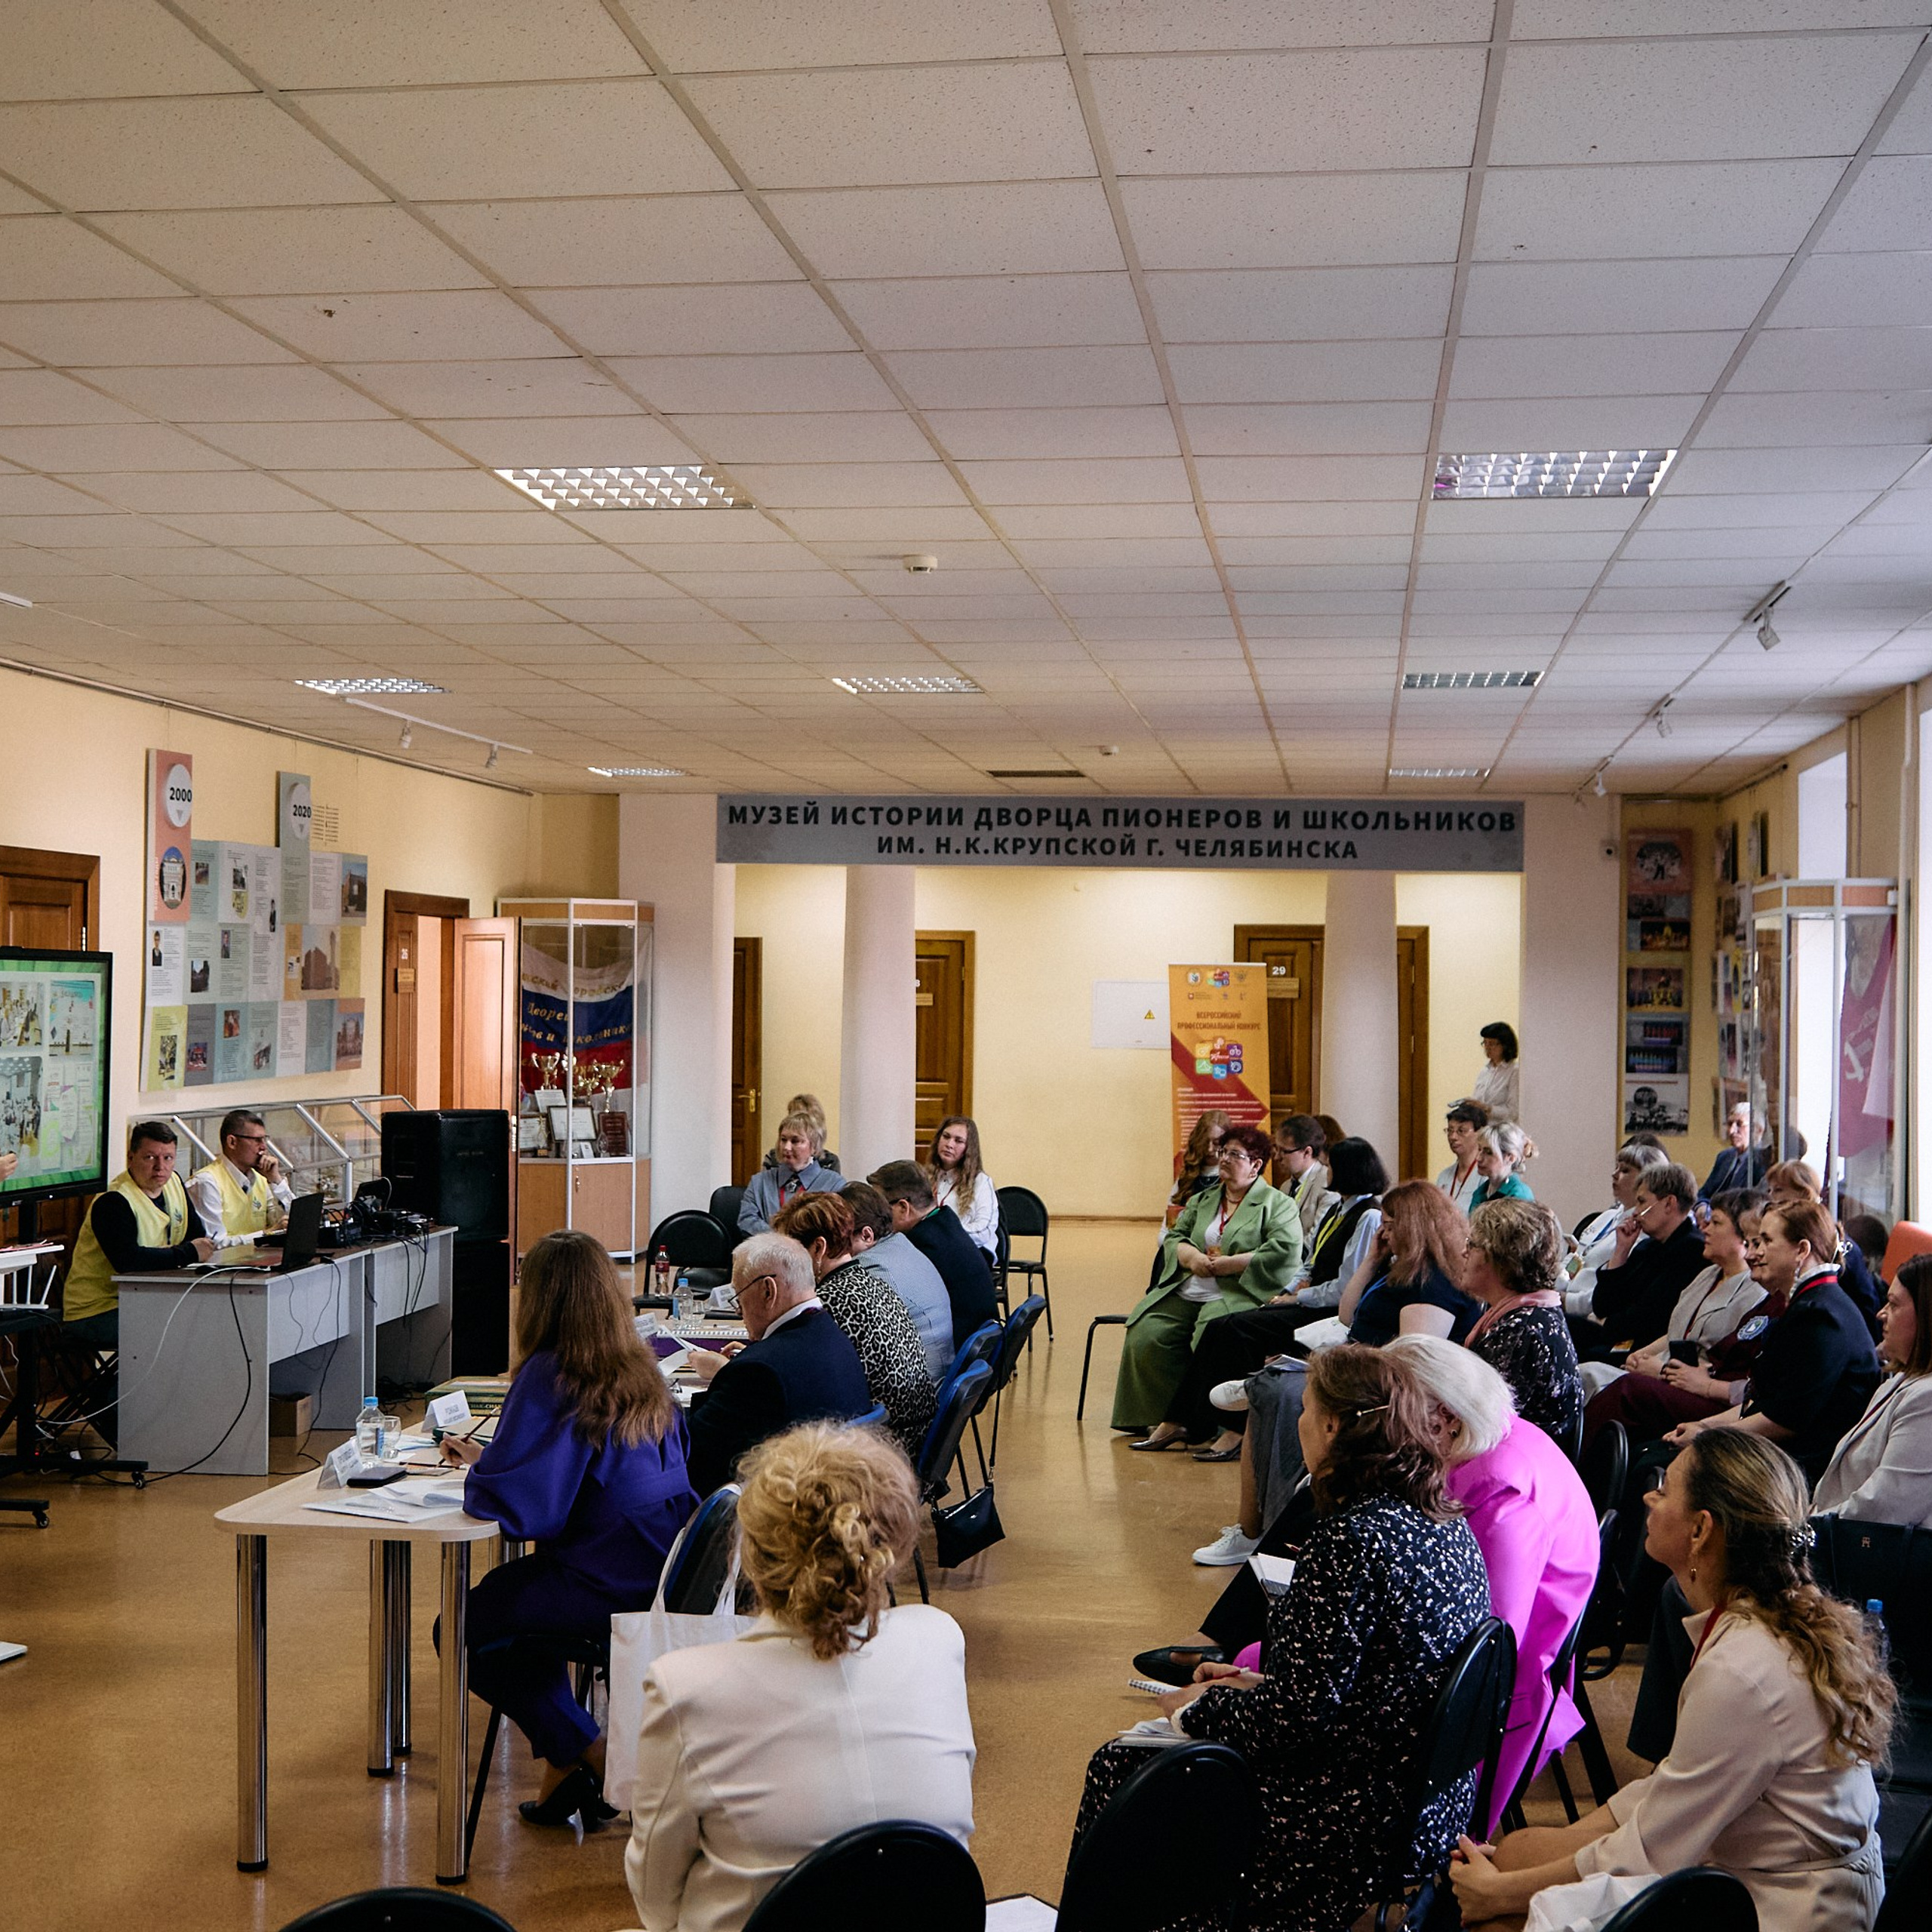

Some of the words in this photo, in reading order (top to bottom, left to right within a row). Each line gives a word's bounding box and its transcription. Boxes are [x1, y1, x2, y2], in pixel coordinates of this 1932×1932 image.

[170, 786, 192, 802] 2000
[292, 804, 312, 819] 2020
[728, 801, 820, 825] МУЗЕЙ
[831, 806, 964, 826] ИСТОРИИ
[974, 807, 1093, 832] ДВОРЦА
[1102, 808, 1263, 829] ПИОНЕРОВ
[1273, 809, 1291, 829] И
[1302, 810, 1516, 831] ШКОЛЬНИКОВ
[877, 835, 924, 854] ИМ.
[935, 833, 1136, 856] Н.К.КРУПСКОЙ
[1146, 838, 1164, 856] Г.
[1175, 838, 1358, 859] ЧЕЛЯБИНСКА
[1272, 965, 1287, 976] 29
